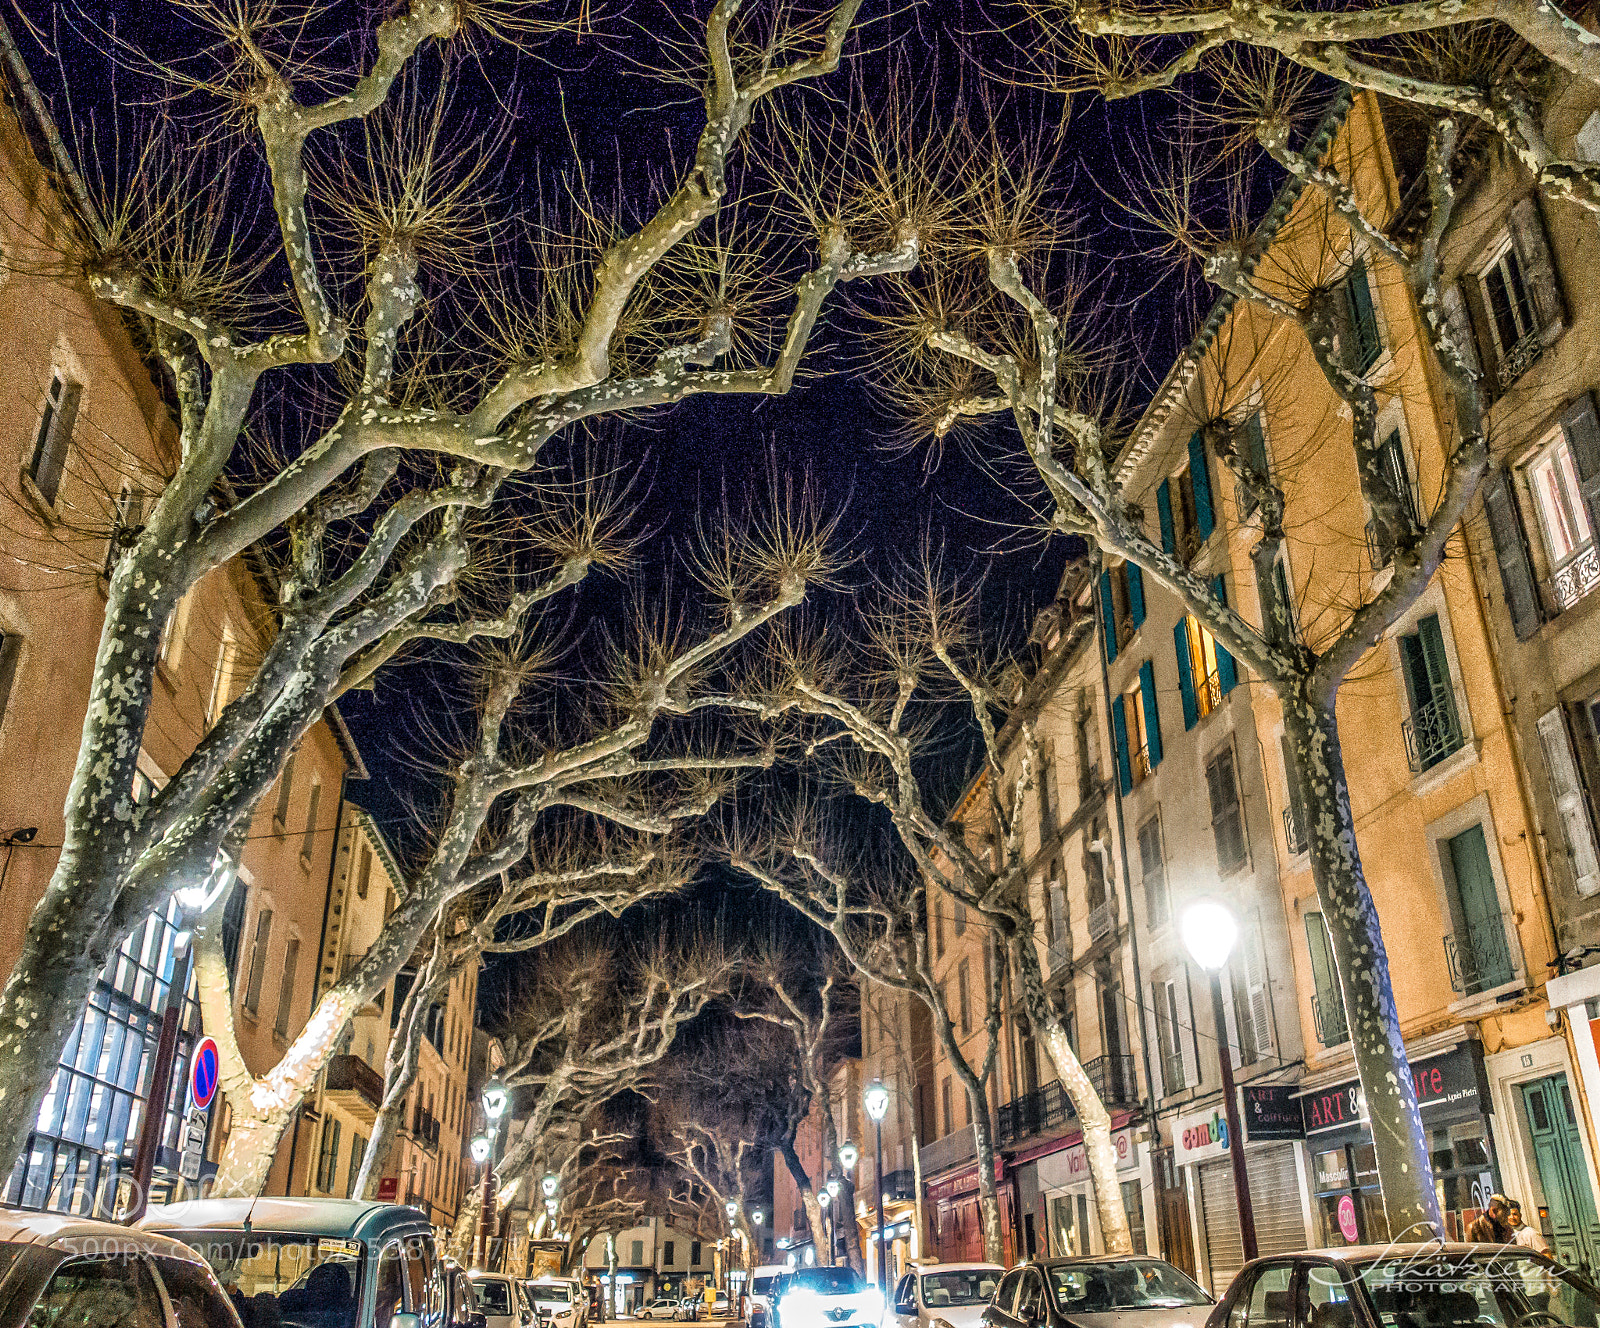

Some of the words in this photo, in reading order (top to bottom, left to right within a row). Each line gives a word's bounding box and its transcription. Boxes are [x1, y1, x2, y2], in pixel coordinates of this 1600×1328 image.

[1248, 1088, 1274, 1101] ART
[1254, 1102, 1262, 1114] &
[1312, 1091, 1344, 1127] ART
[1348, 1086, 1359, 1115] &
